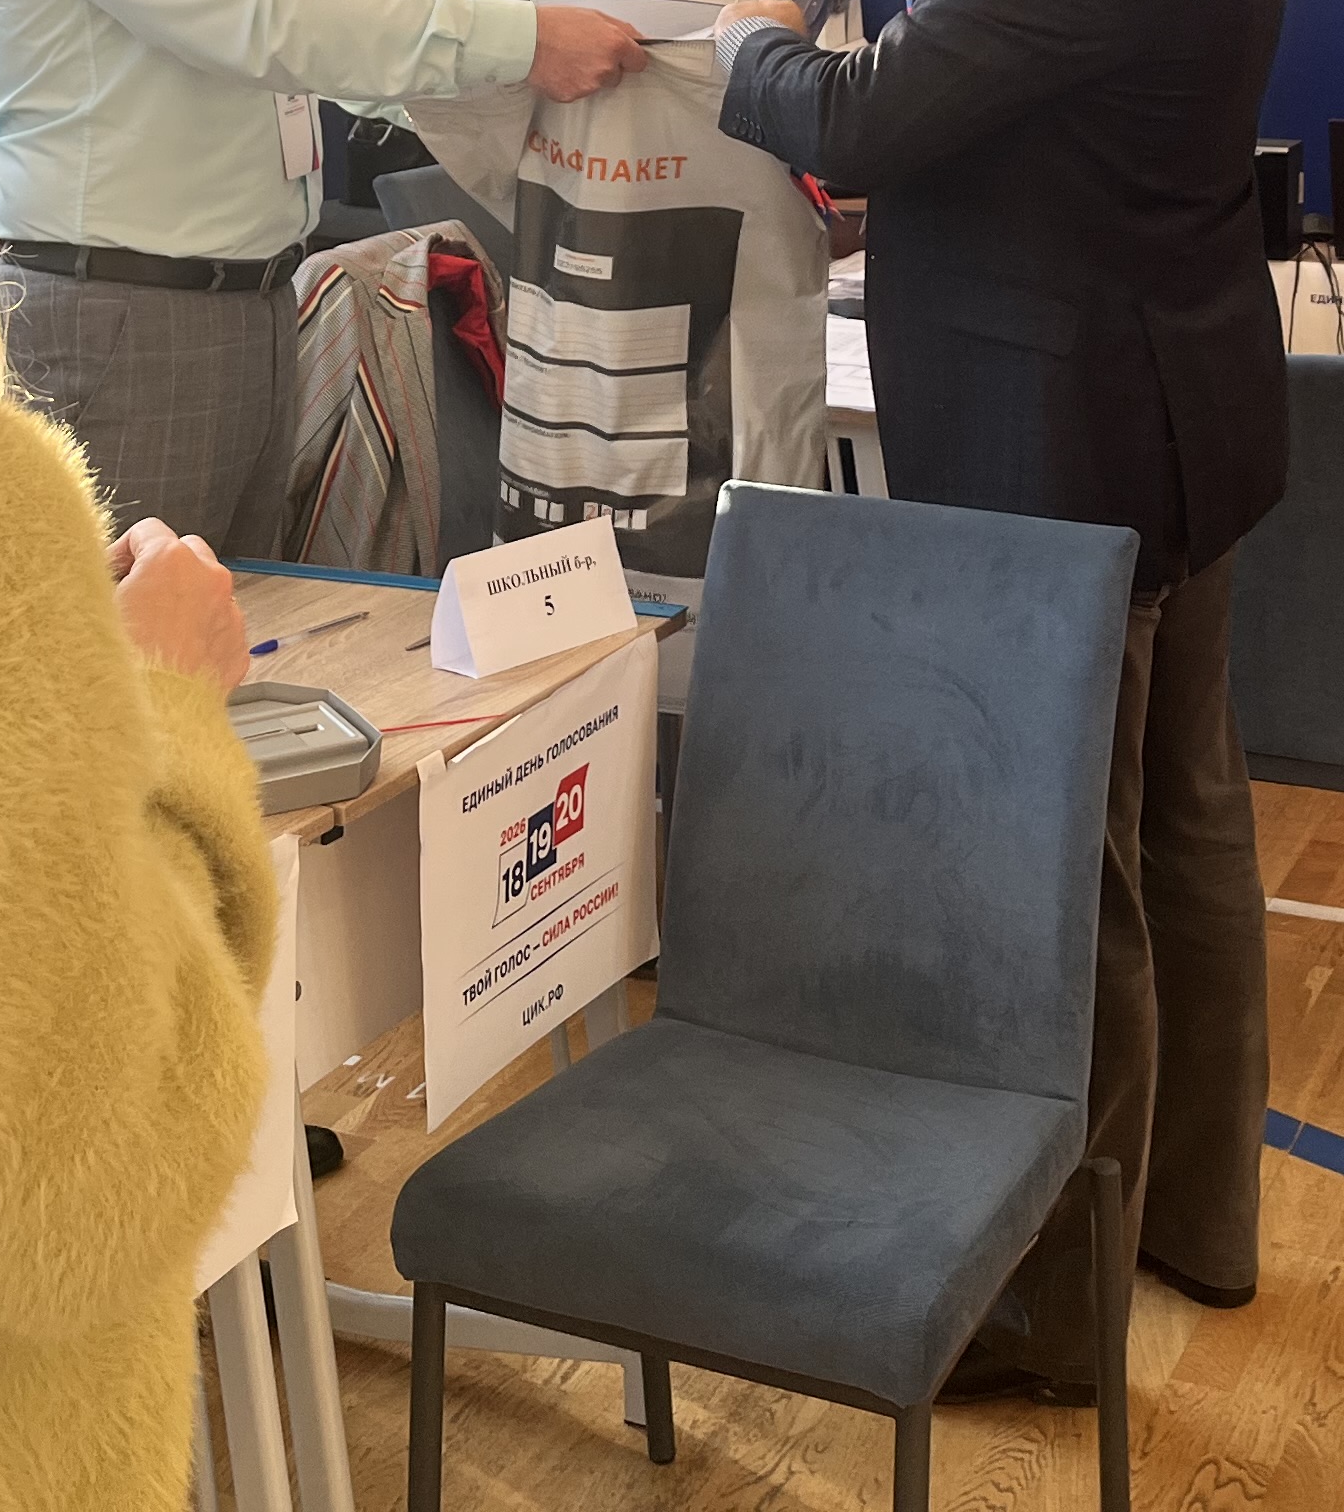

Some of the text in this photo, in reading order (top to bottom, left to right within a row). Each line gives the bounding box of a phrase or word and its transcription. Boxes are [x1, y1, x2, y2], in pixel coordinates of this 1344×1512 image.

[486, 554, 597, 596] ШКОЛЬНЫЙ б-р,
[544, 594, 556, 616] 5
[462, 704, 619, 814] ЕДИНЫЙ ДЕНЬ ГОЛОСОВАНИЯ
[555, 783, 583, 832] 20
[499, 817, 527, 847] 2026
[529, 821, 553, 866] 19
[502, 859, 525, 904] 18
[530, 852, 585, 901] СЕНТЯБРЯ
[462, 968, 492, 1006] ТВОЙ
[494, 944, 531, 983] ГОЛОС
[542, 915, 571, 947] СИЛА
[572, 881, 619, 925] РОССИИ!
[522, 983, 565, 1026] ЦИК.РФ
